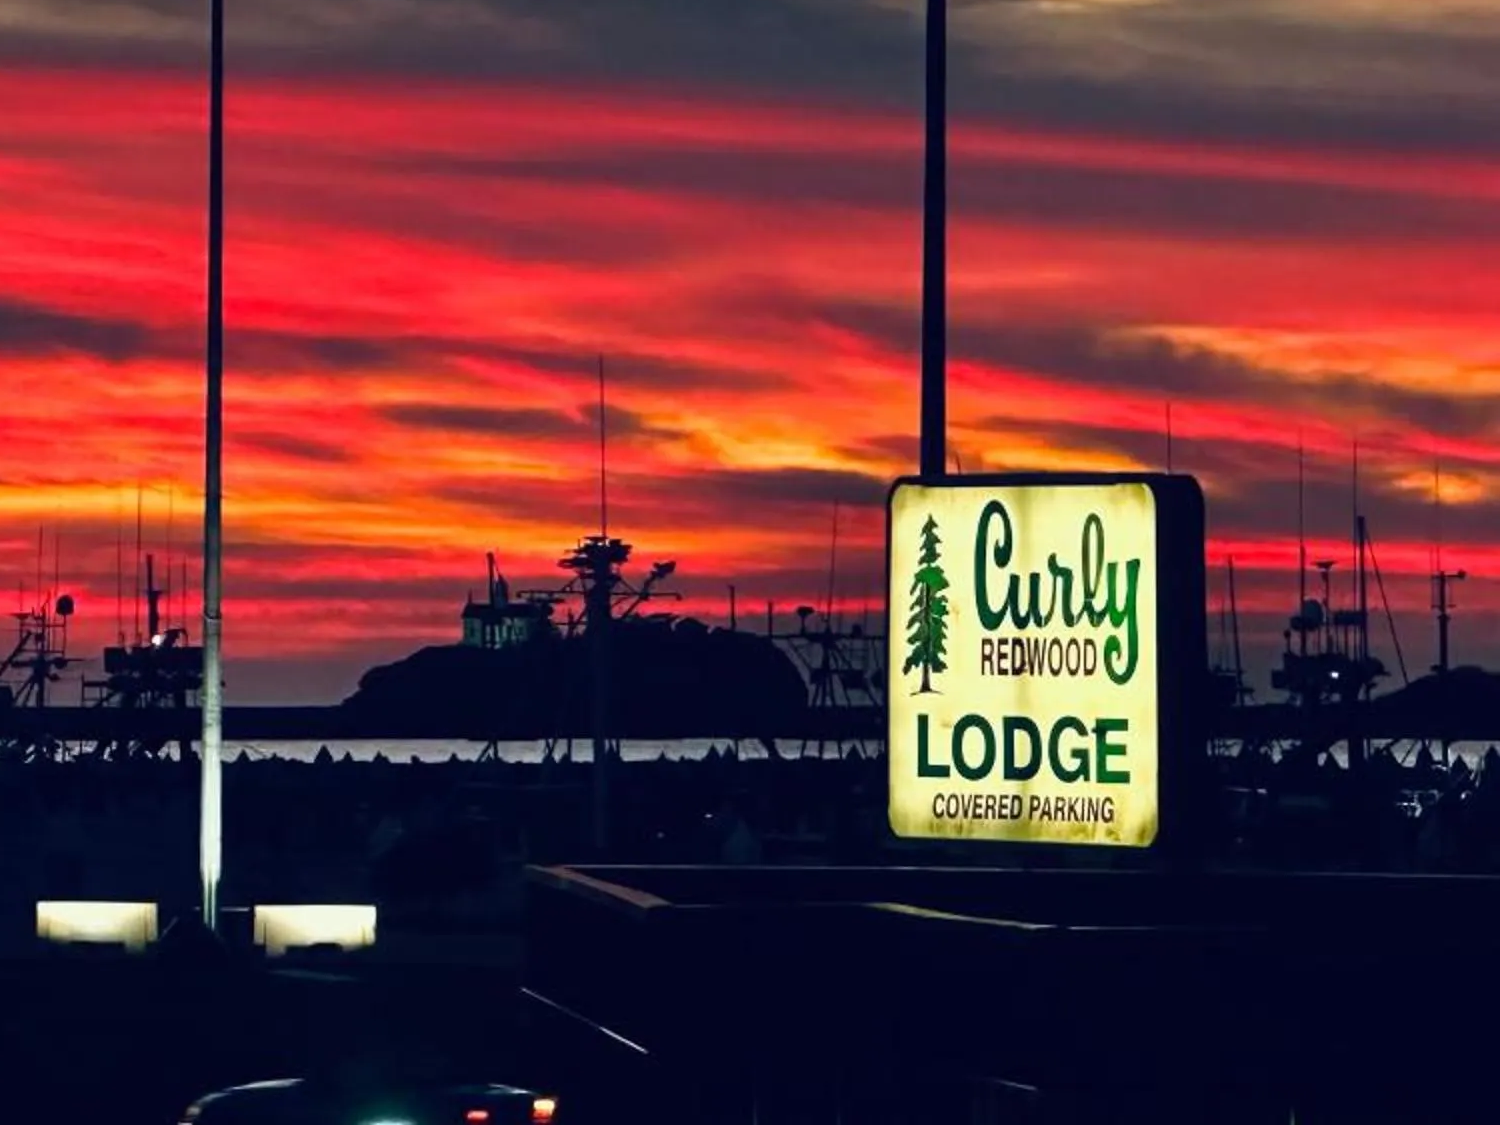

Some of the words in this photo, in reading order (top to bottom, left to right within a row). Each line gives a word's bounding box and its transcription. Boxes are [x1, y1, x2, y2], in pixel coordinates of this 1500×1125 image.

[974, 500, 1141, 685] Curly
[981, 637, 1097, 676] REDWOOD
[917, 714, 1131, 784] LODGE
[933, 793, 1022, 820] COVERED
[1029, 795, 1115, 823] PARKING
